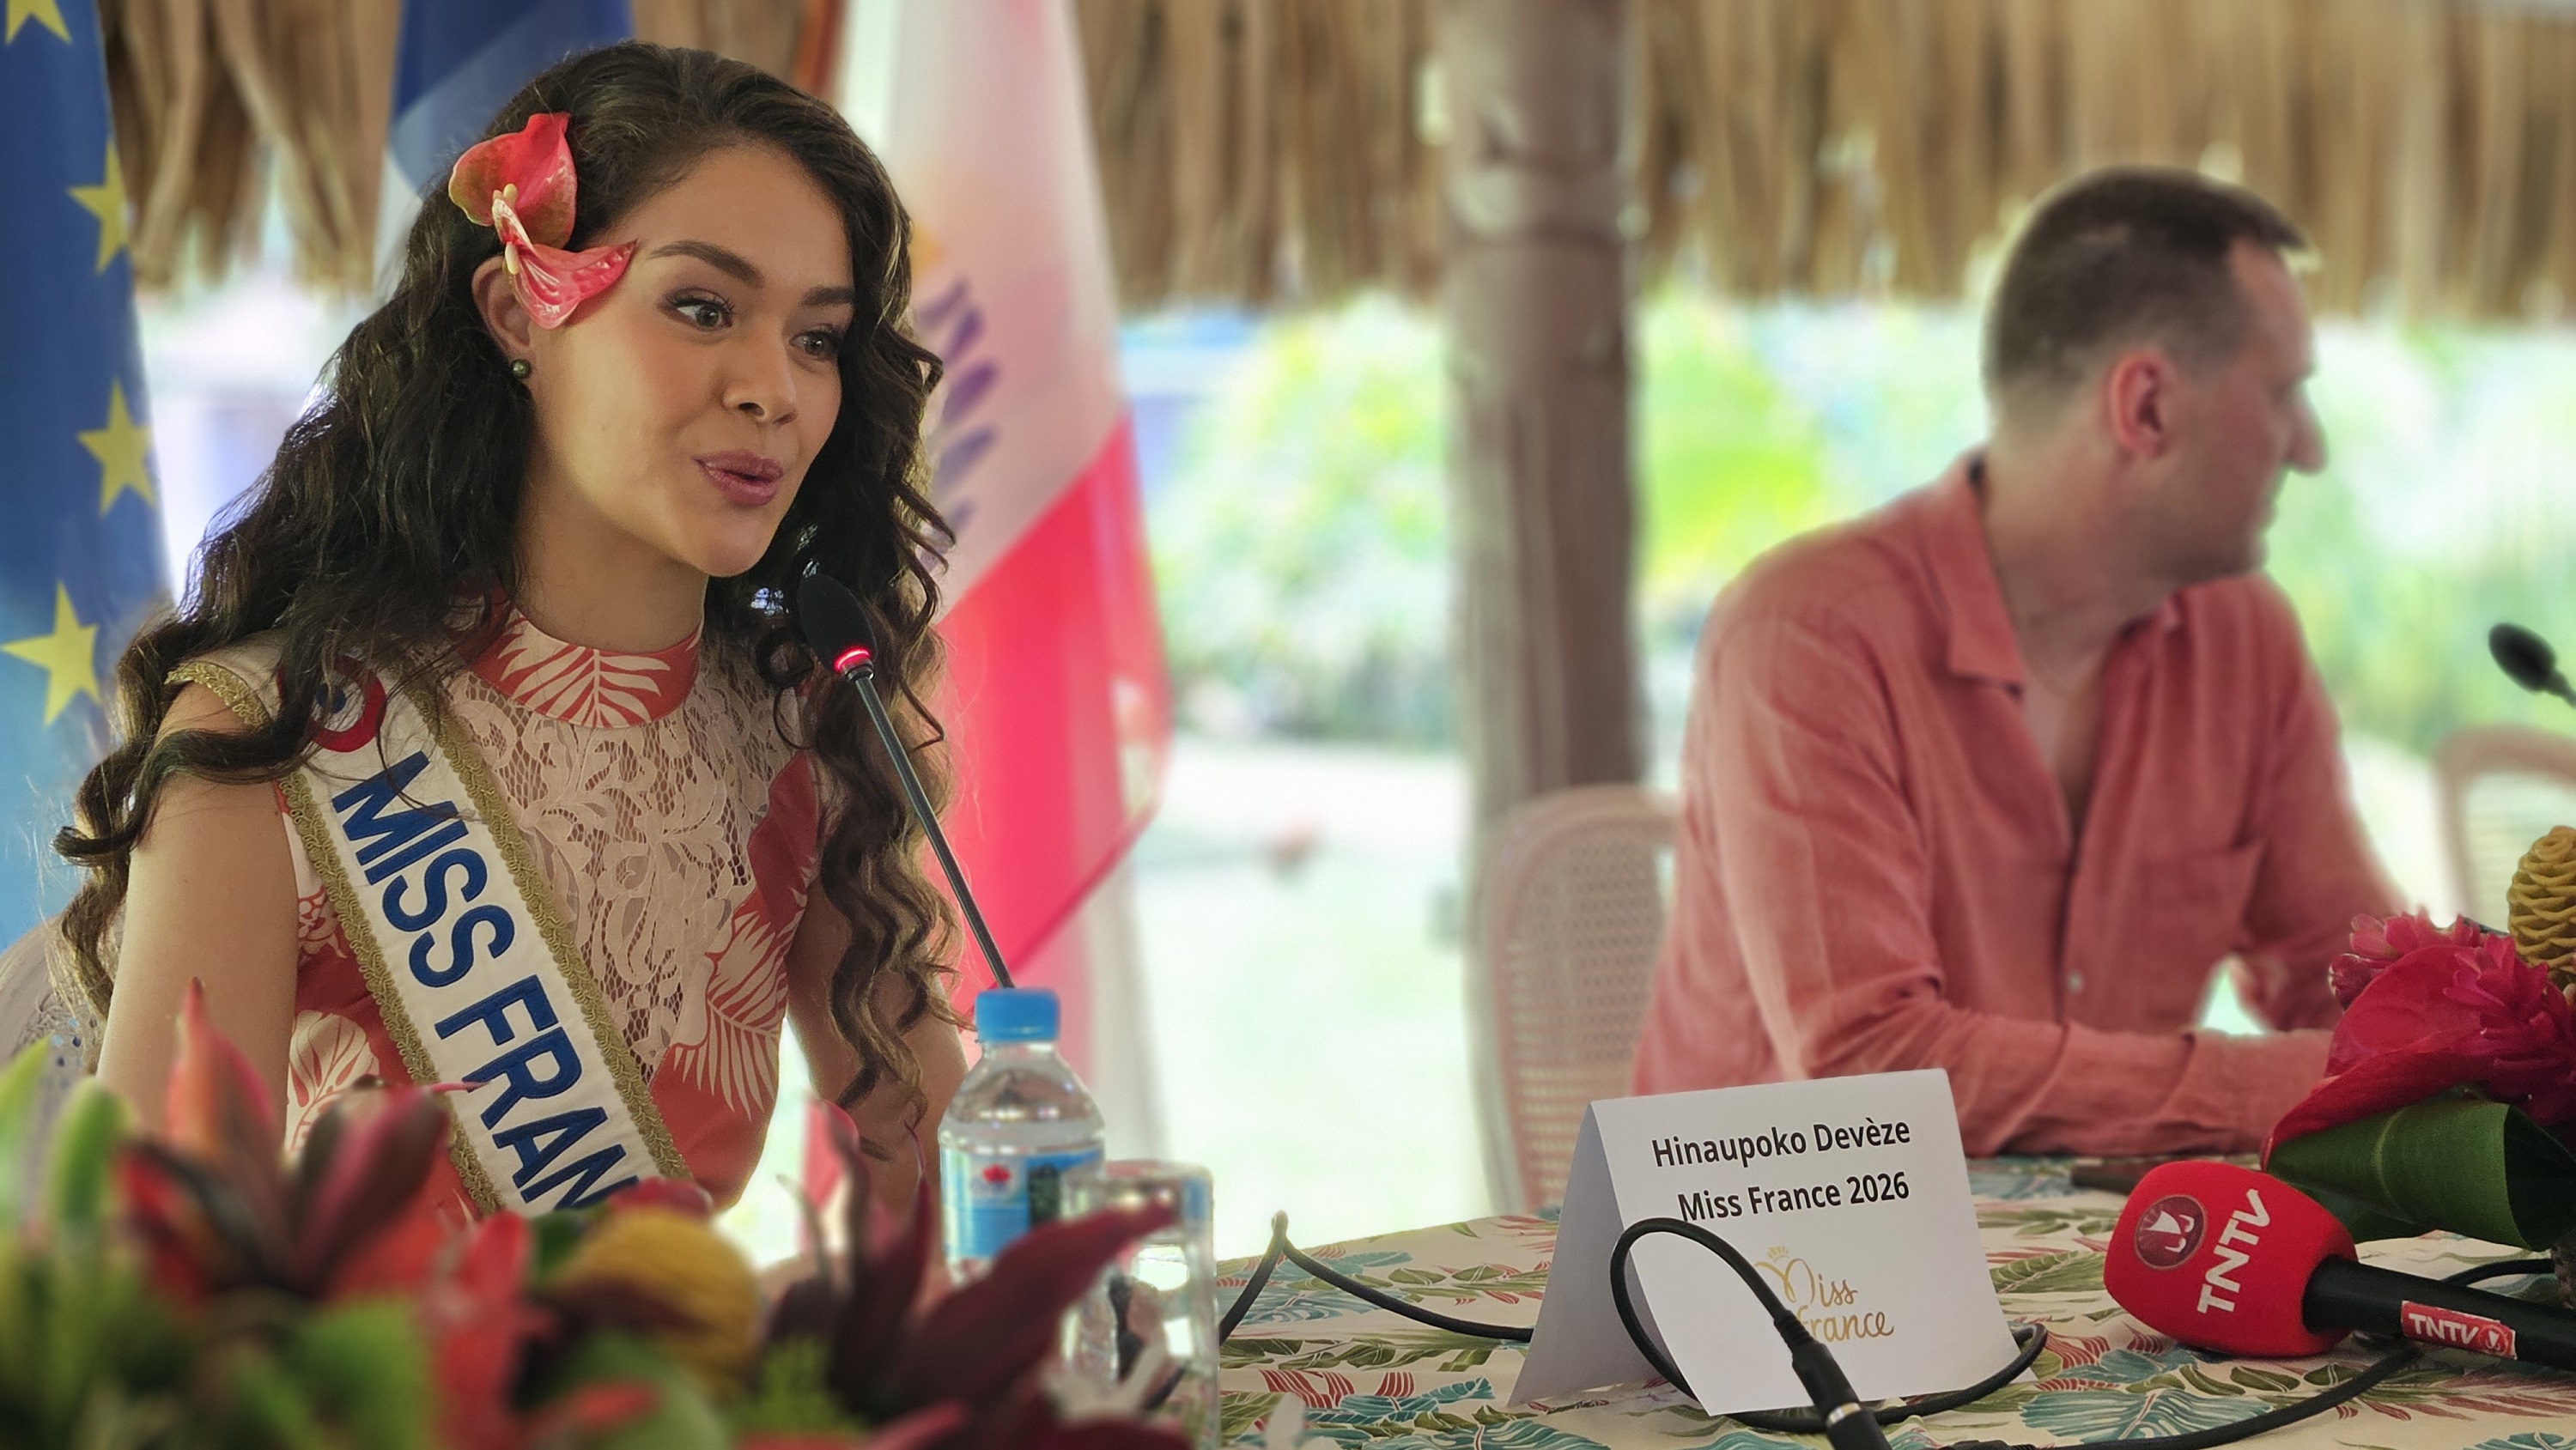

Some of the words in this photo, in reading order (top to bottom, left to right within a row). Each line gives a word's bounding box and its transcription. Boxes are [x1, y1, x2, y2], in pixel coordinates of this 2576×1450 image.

[331, 751, 515, 987] MISS
[1652, 1126, 1807, 1168] Hinaupoko
[1814, 1117, 1911, 1152] Devèze
[1678, 1190, 1742, 1222] Miss
[1747, 1184, 1841, 1214] France
[1846, 1172, 1910, 1204] 2026
[2197, 1188, 2270, 1314] TNTV
[1754, 1258, 1858, 1307] Miss
[2408, 1313, 2479, 1345] TNTV
